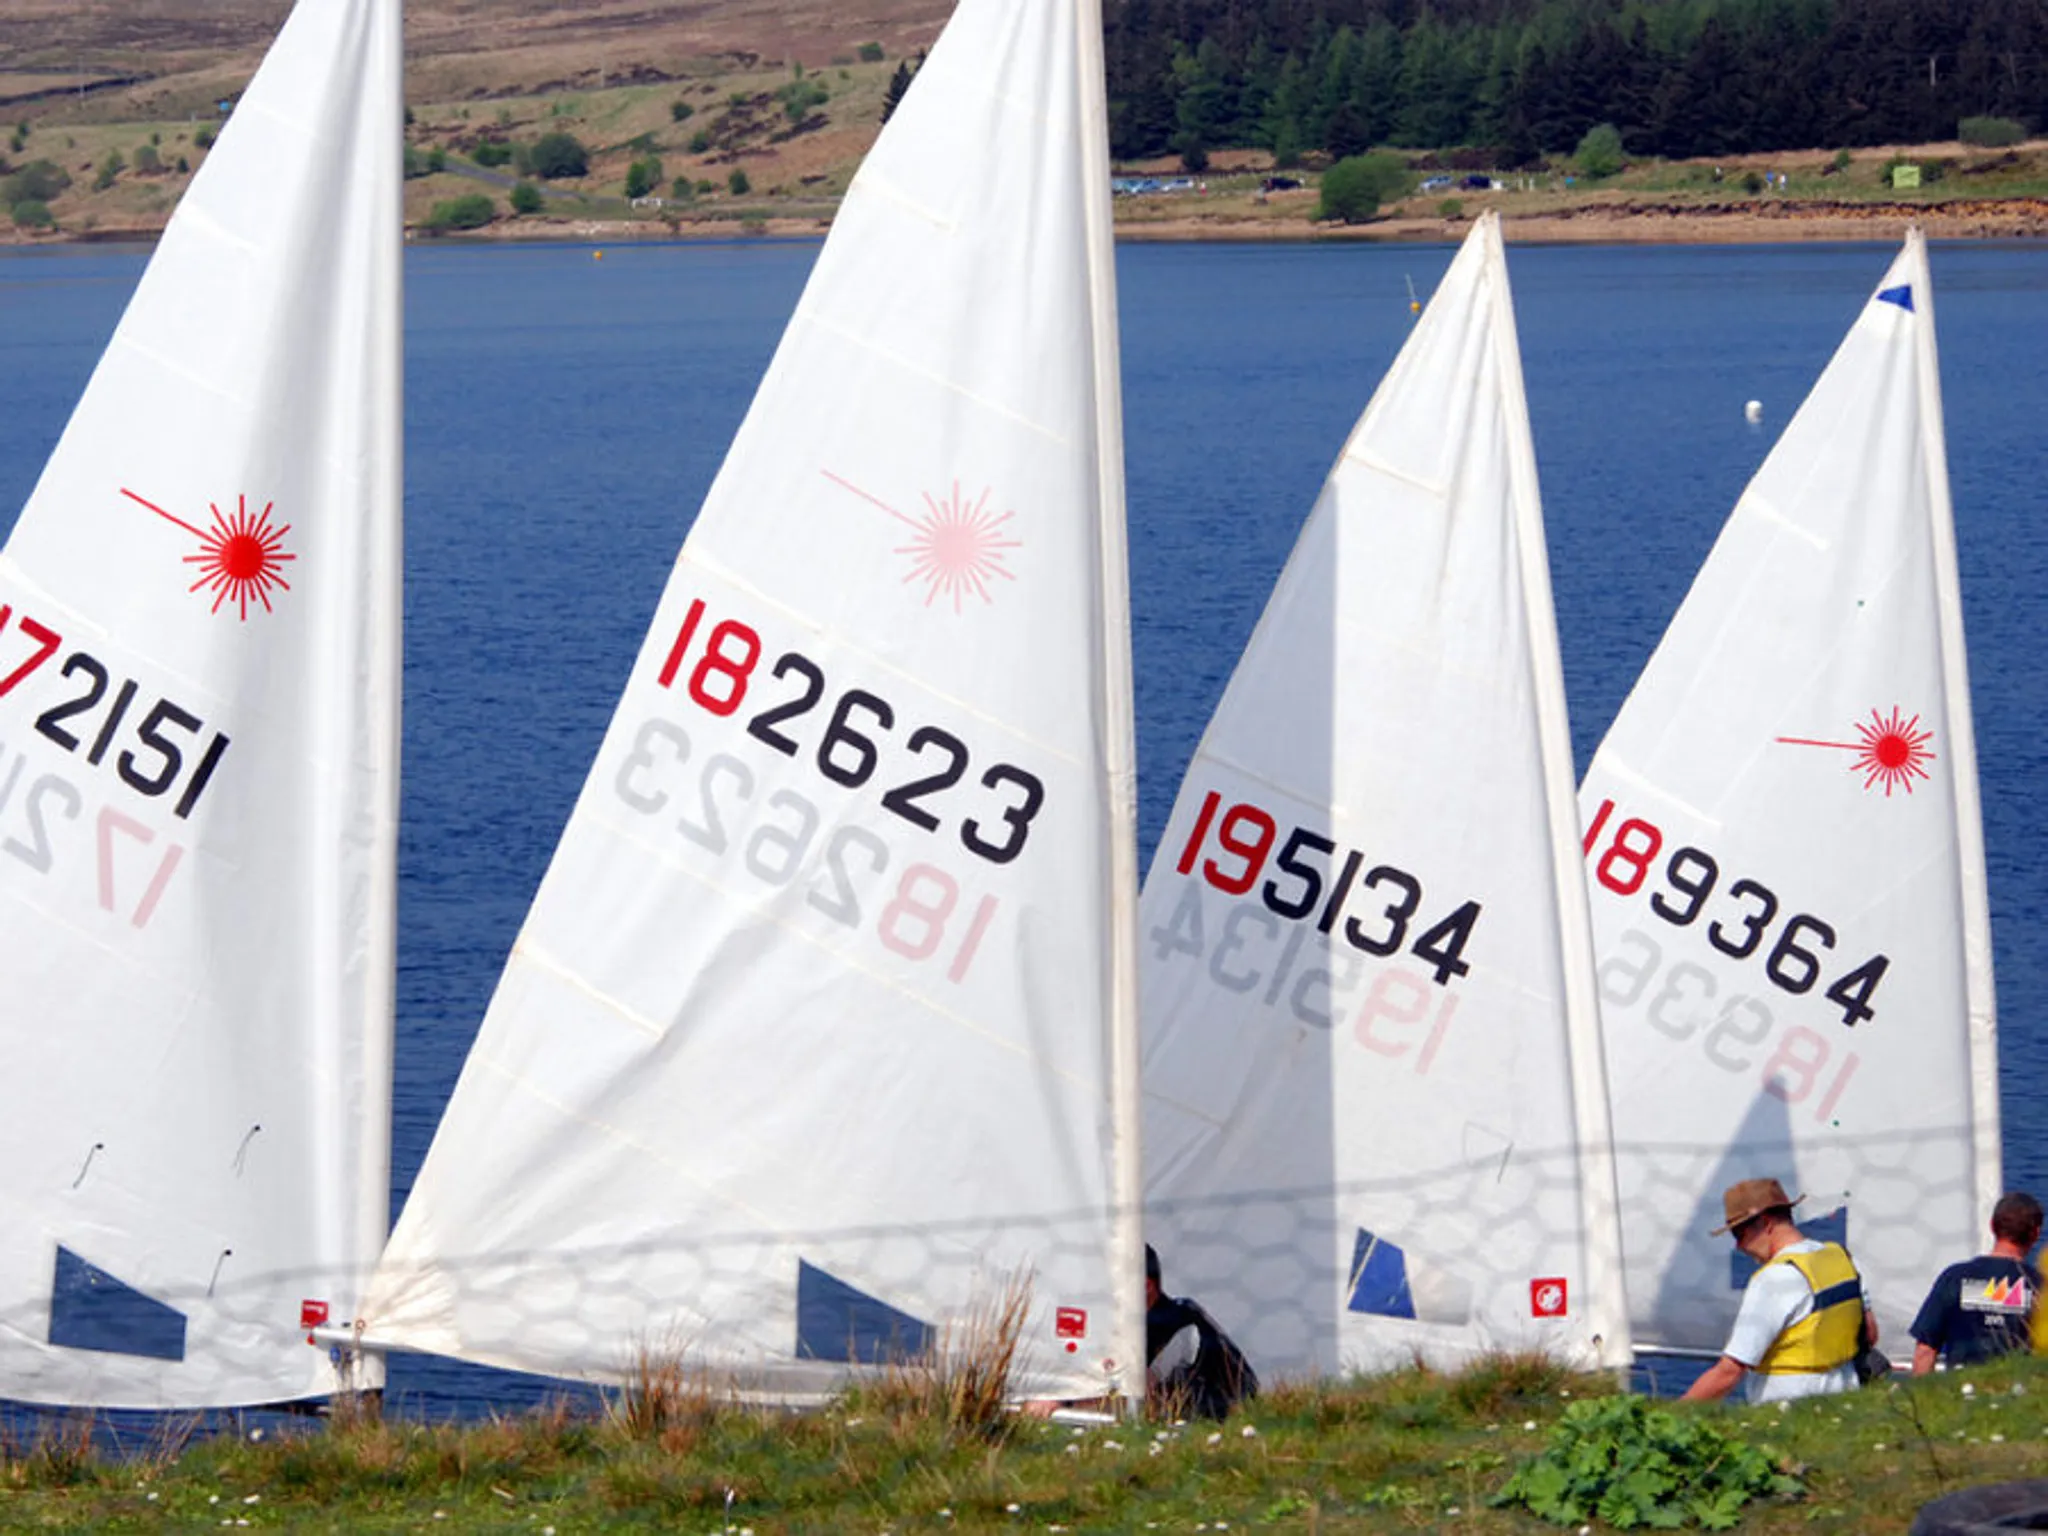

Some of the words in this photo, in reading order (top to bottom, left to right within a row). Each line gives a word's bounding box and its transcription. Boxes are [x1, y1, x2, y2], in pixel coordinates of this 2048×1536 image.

[658, 598, 1044, 864] 182623
[1176, 791, 1482, 986] 195134
[1582, 799, 1890, 1027] 189364
